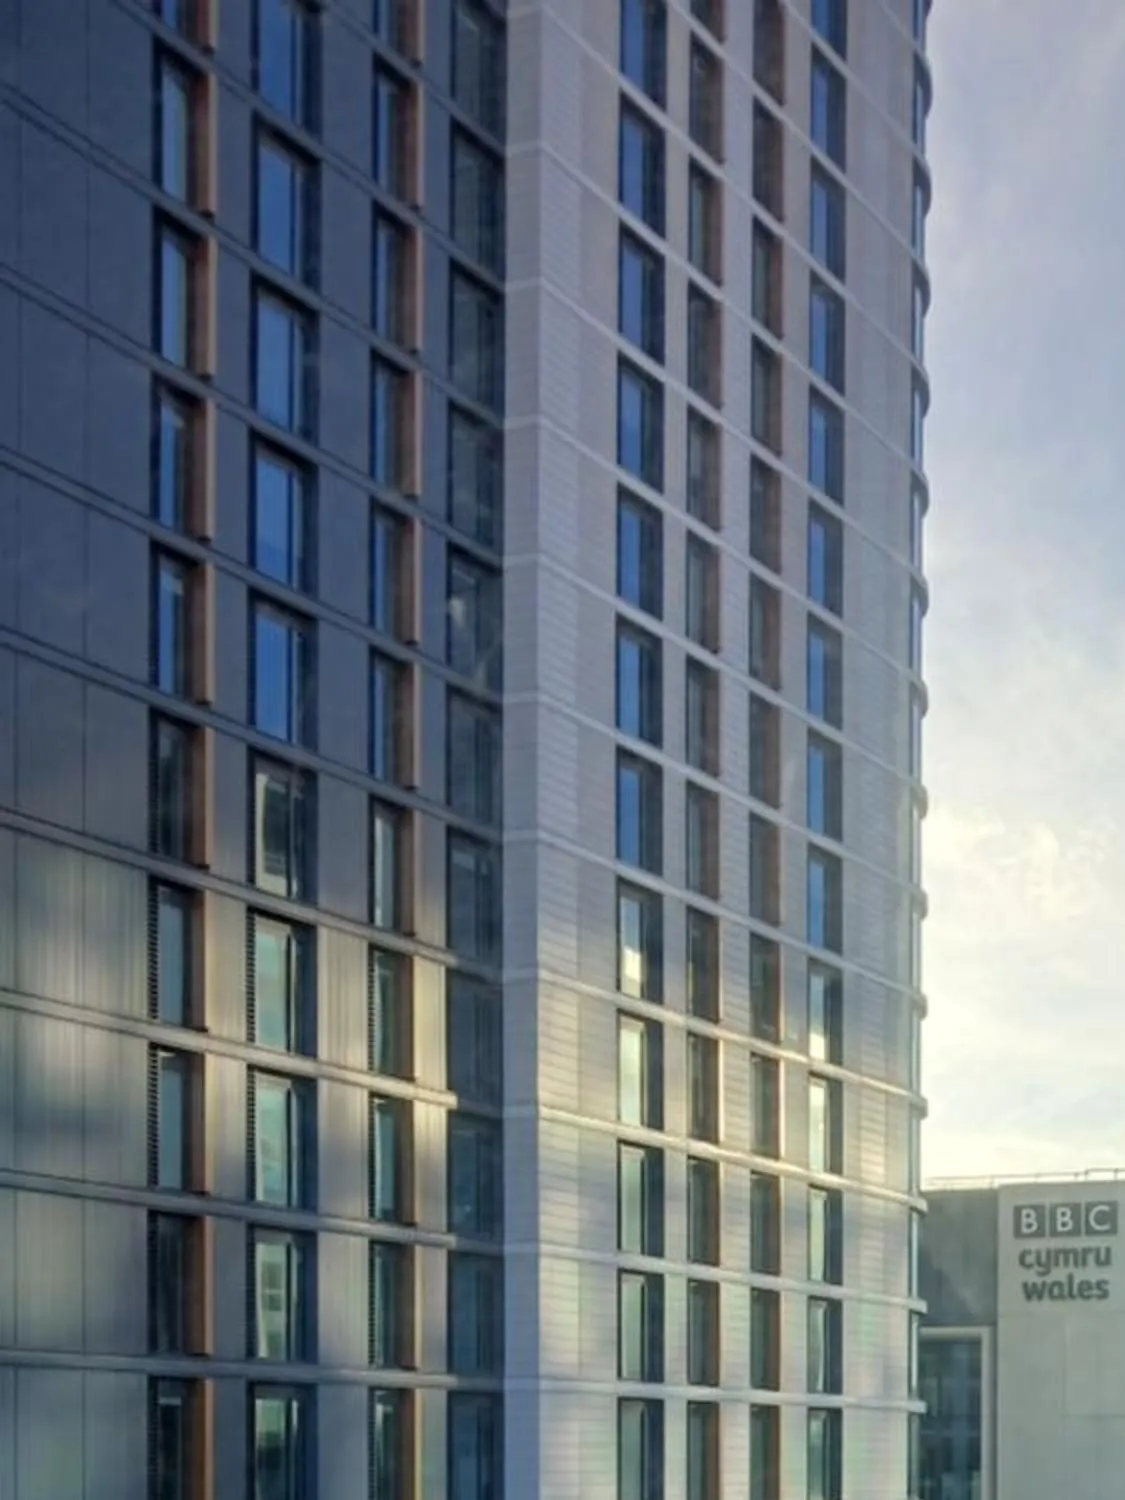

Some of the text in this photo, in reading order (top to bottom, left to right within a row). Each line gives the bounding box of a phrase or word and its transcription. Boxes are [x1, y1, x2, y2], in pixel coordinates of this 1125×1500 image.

[1016, 1202, 1116, 1237] BBC
[1018, 1245, 1112, 1277] cymru
[1022, 1272, 1110, 1302] wales
